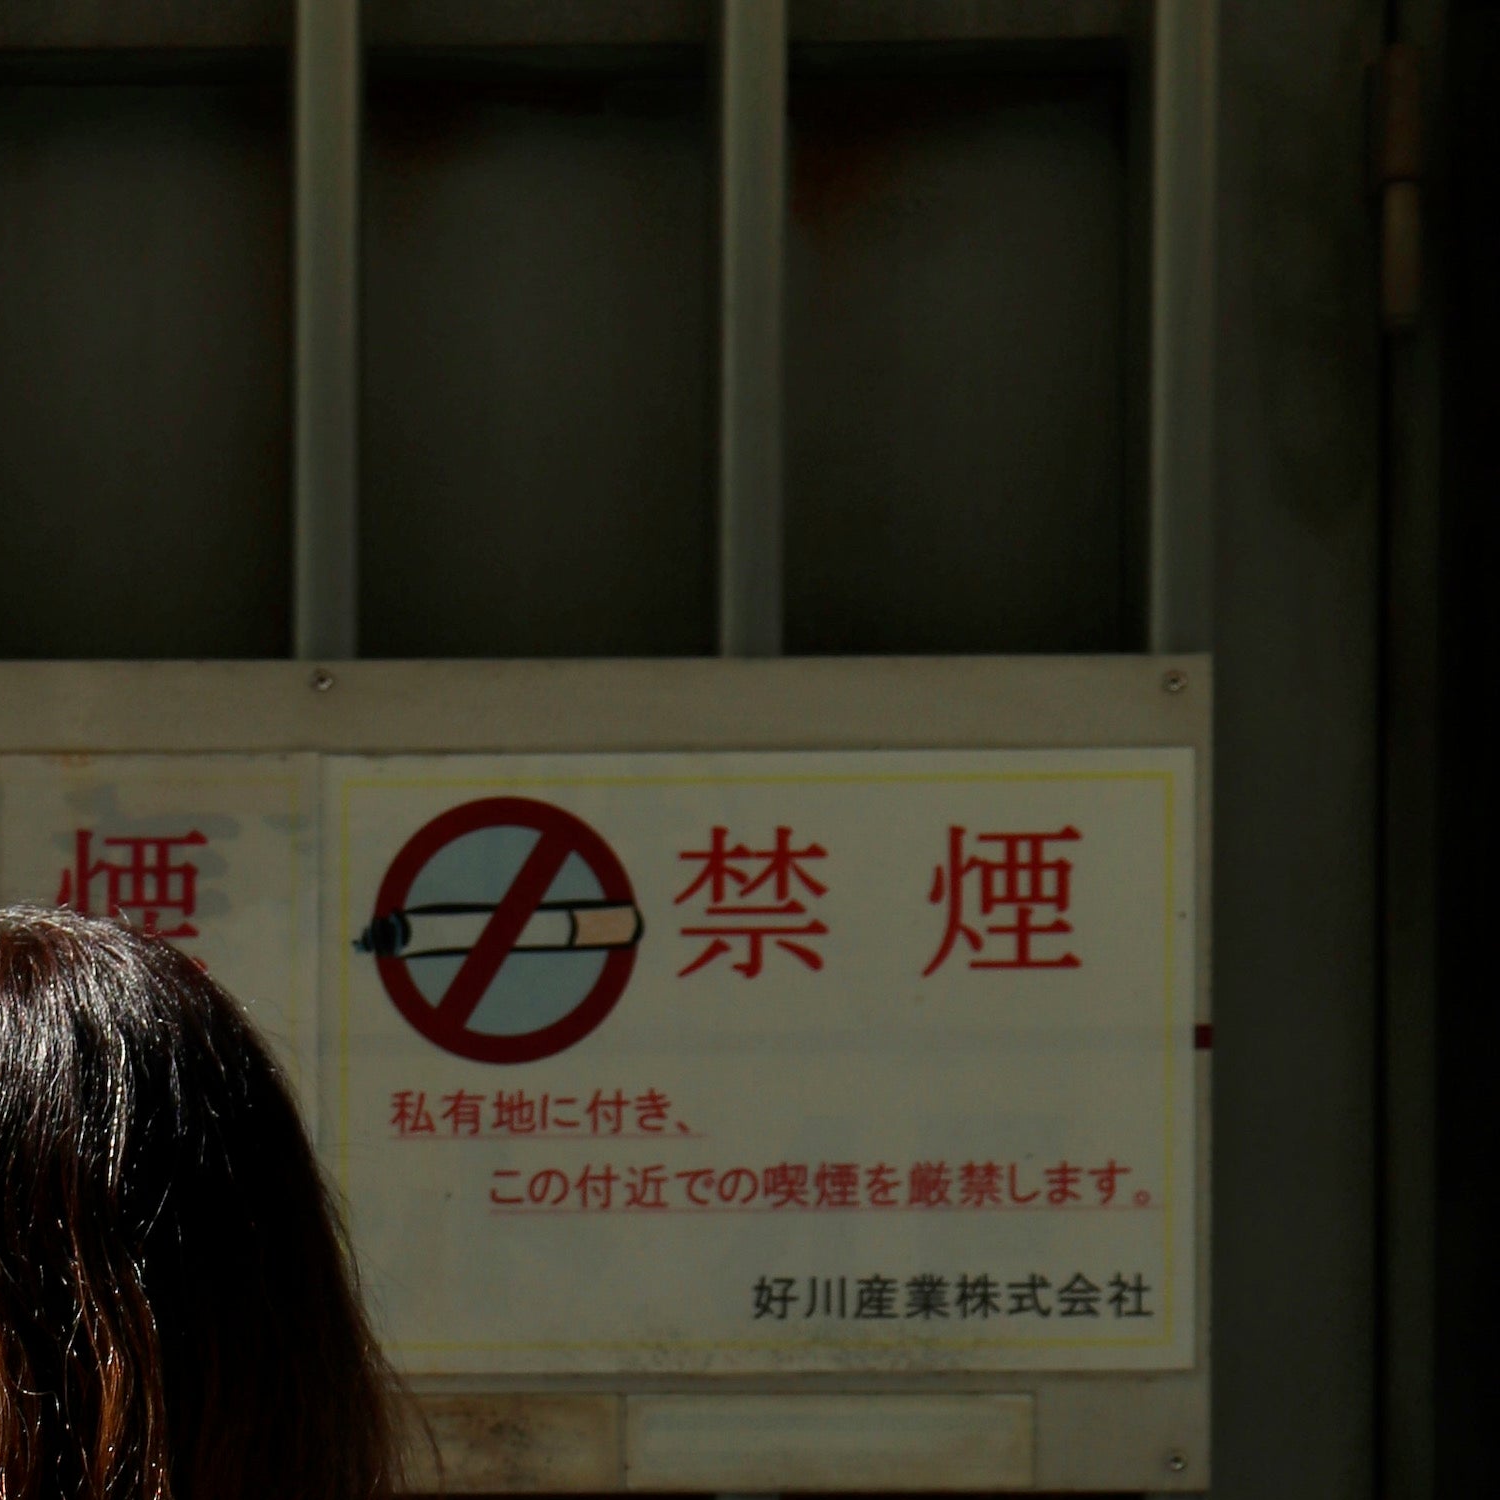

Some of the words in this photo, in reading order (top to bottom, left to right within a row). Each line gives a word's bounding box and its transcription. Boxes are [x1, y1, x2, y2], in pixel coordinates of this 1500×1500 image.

[674, 825, 1082, 979] 禁煙
[391, 1090, 692, 1135] 私有地に付き、
[489, 1159, 1152, 1209] この付近での喫煙を厳禁します。
[752, 1272, 1154, 1321] 好川産業株式会社
